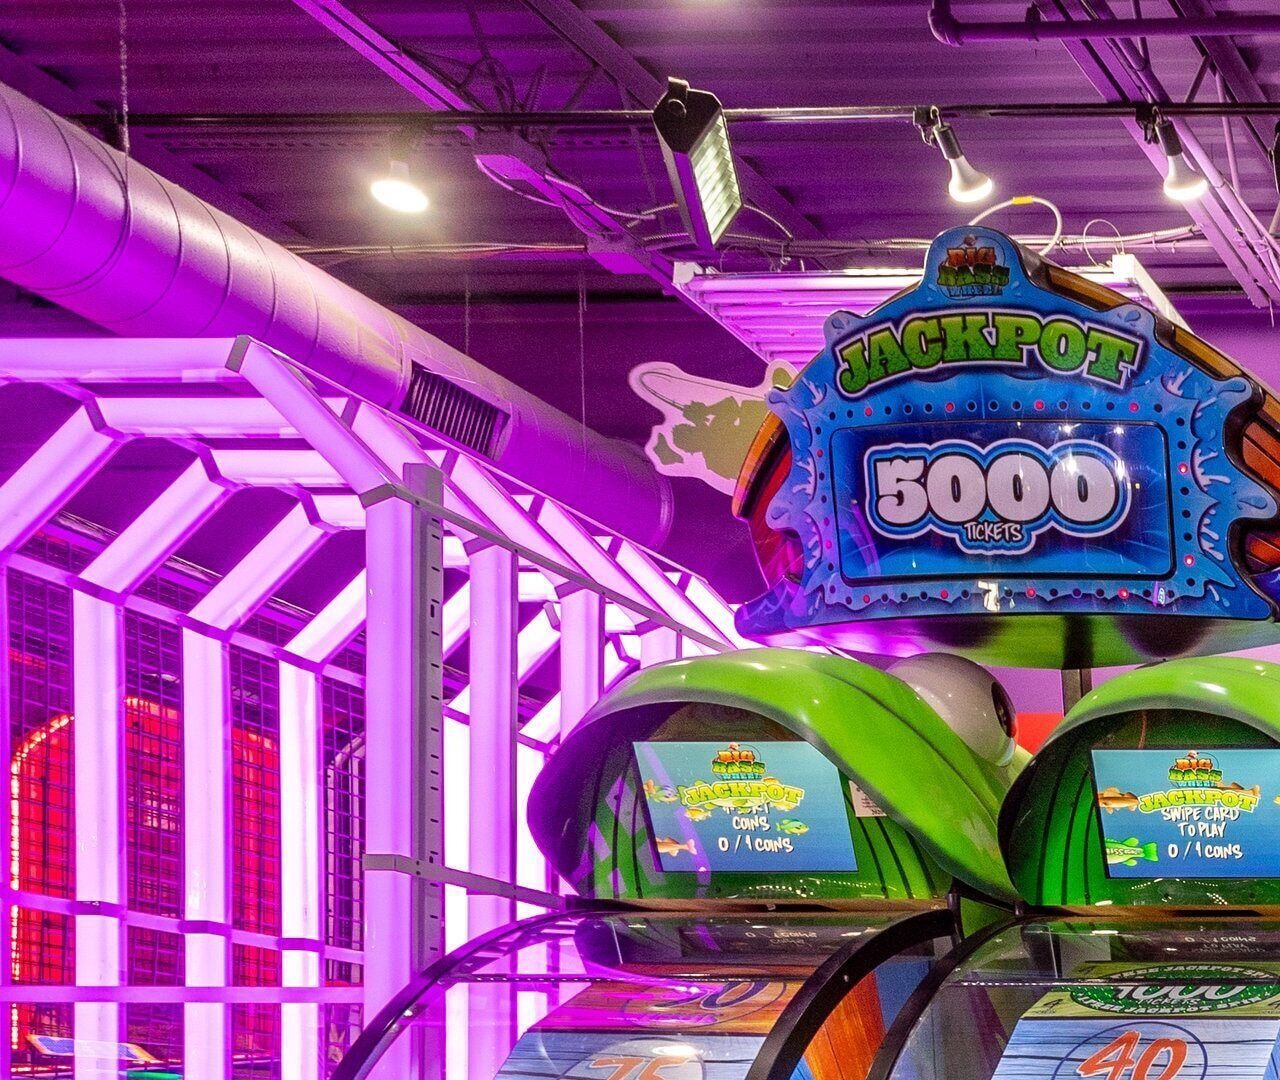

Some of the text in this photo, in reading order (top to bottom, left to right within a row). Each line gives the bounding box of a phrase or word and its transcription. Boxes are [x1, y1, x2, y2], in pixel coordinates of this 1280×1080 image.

[833, 311, 1144, 395] JACKPOT
[876, 454, 1117, 525] 5000
[963, 520, 1023, 544] TICKETS
[684, 781, 804, 808] JACKPOT
[1138, 789, 1260, 813] JACKPOT
[732, 816, 770, 832] COINS
[1161, 806, 1239, 822] SWIPE CARD
[1178, 822, 1226, 838] TO PLAY
[718, 837, 730, 851] 0
[756, 837, 794, 853] COINS
[1168, 844, 1178, 858] 0
[1205, 844, 1243, 859] COINS
